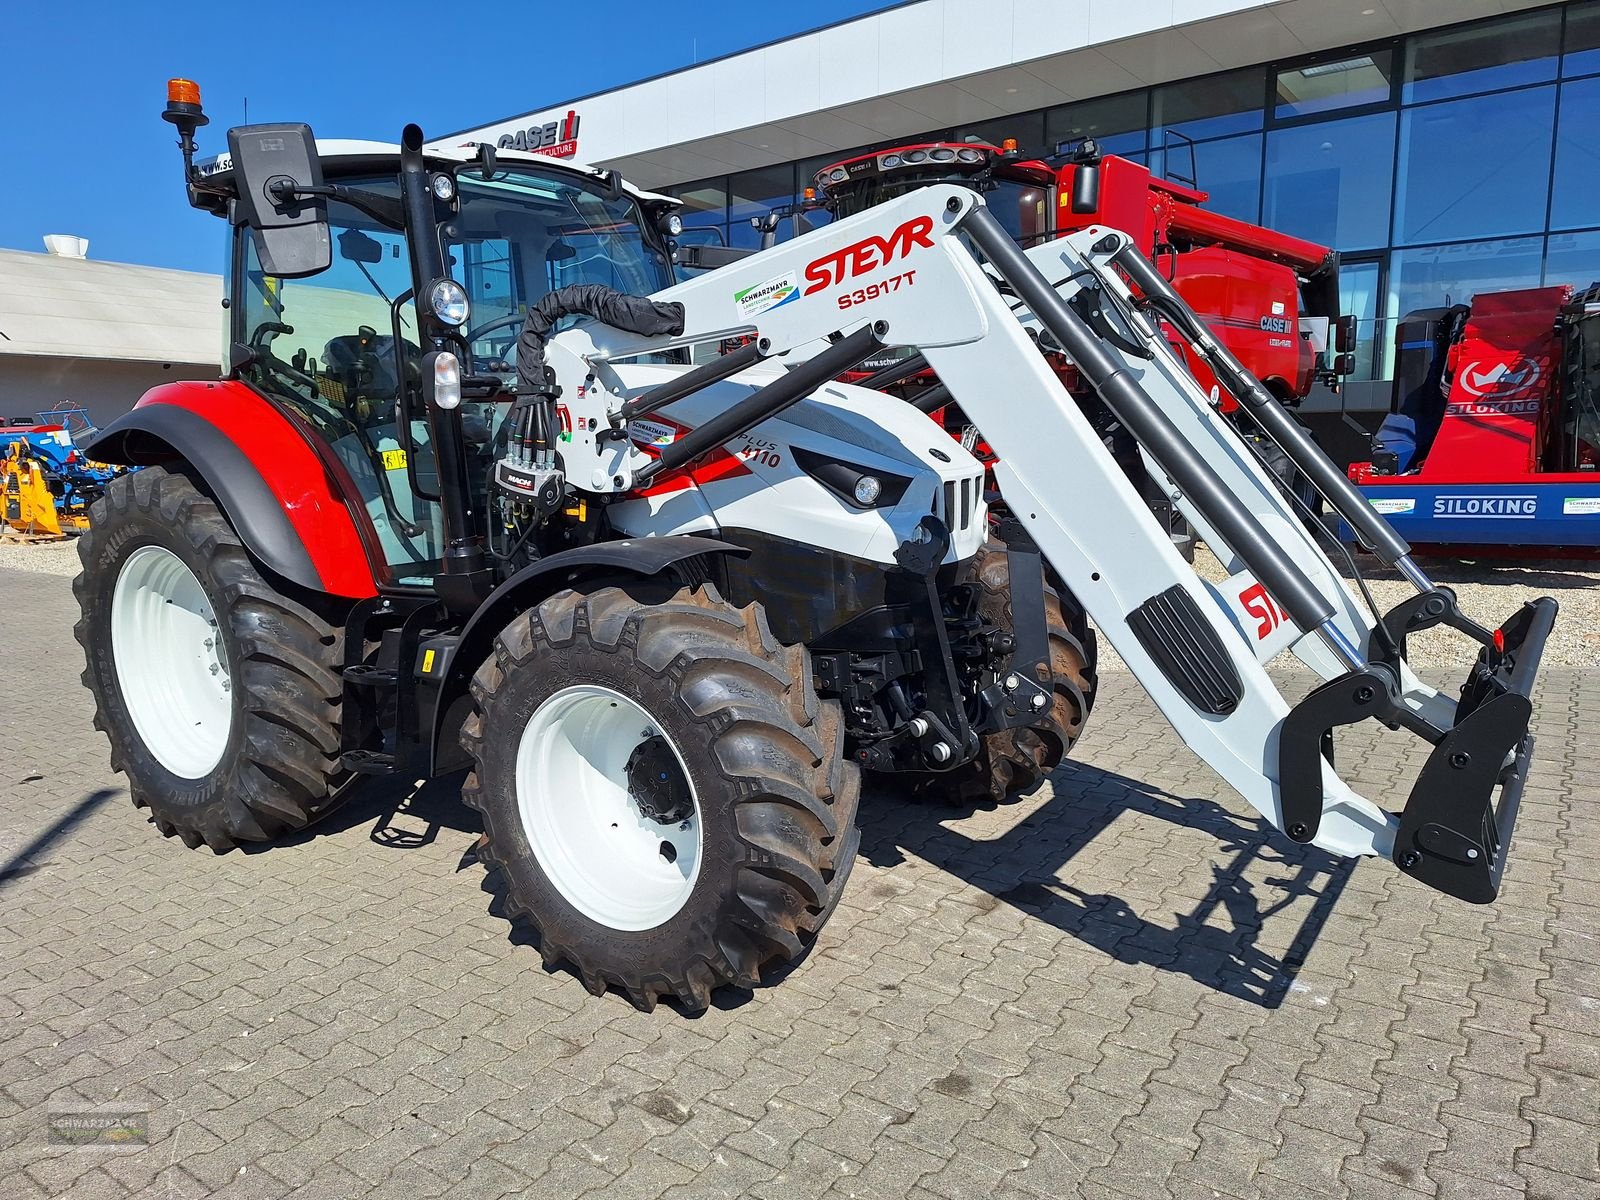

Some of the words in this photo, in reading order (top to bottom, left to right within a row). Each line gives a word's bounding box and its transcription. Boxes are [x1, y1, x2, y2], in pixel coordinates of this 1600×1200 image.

[497, 122, 558, 151] CASE
[850, 164, 865, 172] CASE
[804, 215, 936, 297] STEYR
[740, 279, 788, 305] SCHWARZMAYR
[837, 269, 917, 310] S3917T
[1260, 315, 1284, 333] CASE
[1446, 401, 1540, 415] SILOKING
[632, 420, 669, 437] SCHWARZMAYR
[737, 433, 779, 451] PLUS
[740, 444, 781, 468] 4110
[507, 474, 532, 487] MACH
[1433, 499, 1537, 514] SILOKING
